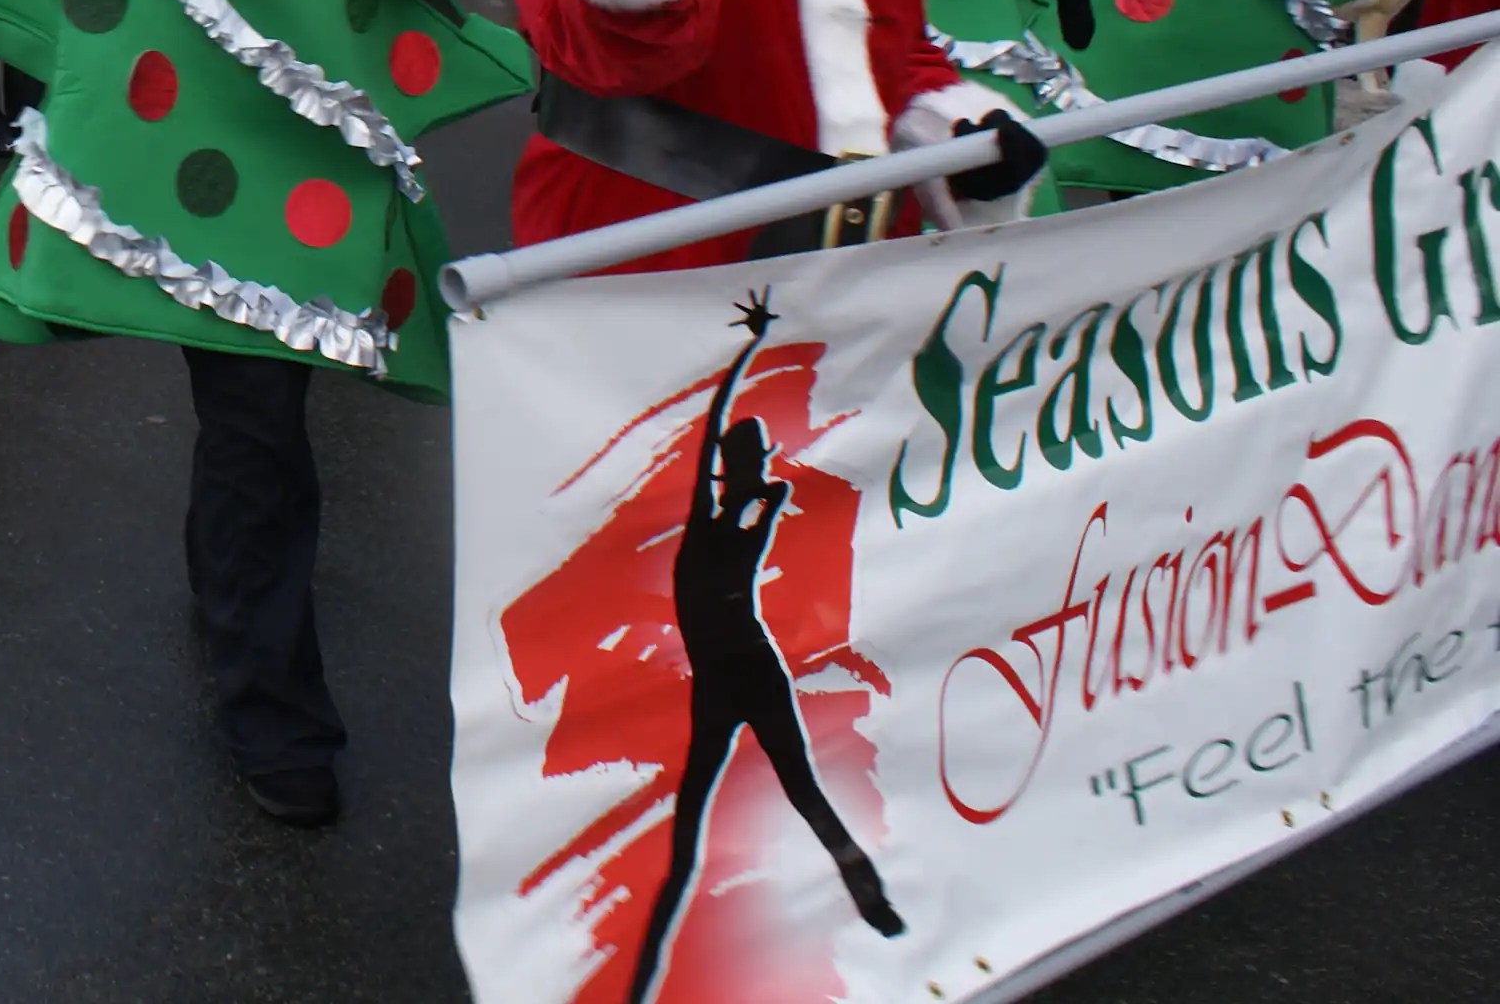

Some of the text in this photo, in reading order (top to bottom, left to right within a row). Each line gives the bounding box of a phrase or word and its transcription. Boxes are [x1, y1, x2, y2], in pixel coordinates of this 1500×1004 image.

[889, 209, 1342, 529] Seasons
[1088, 631, 1463, 826] "Feel the
